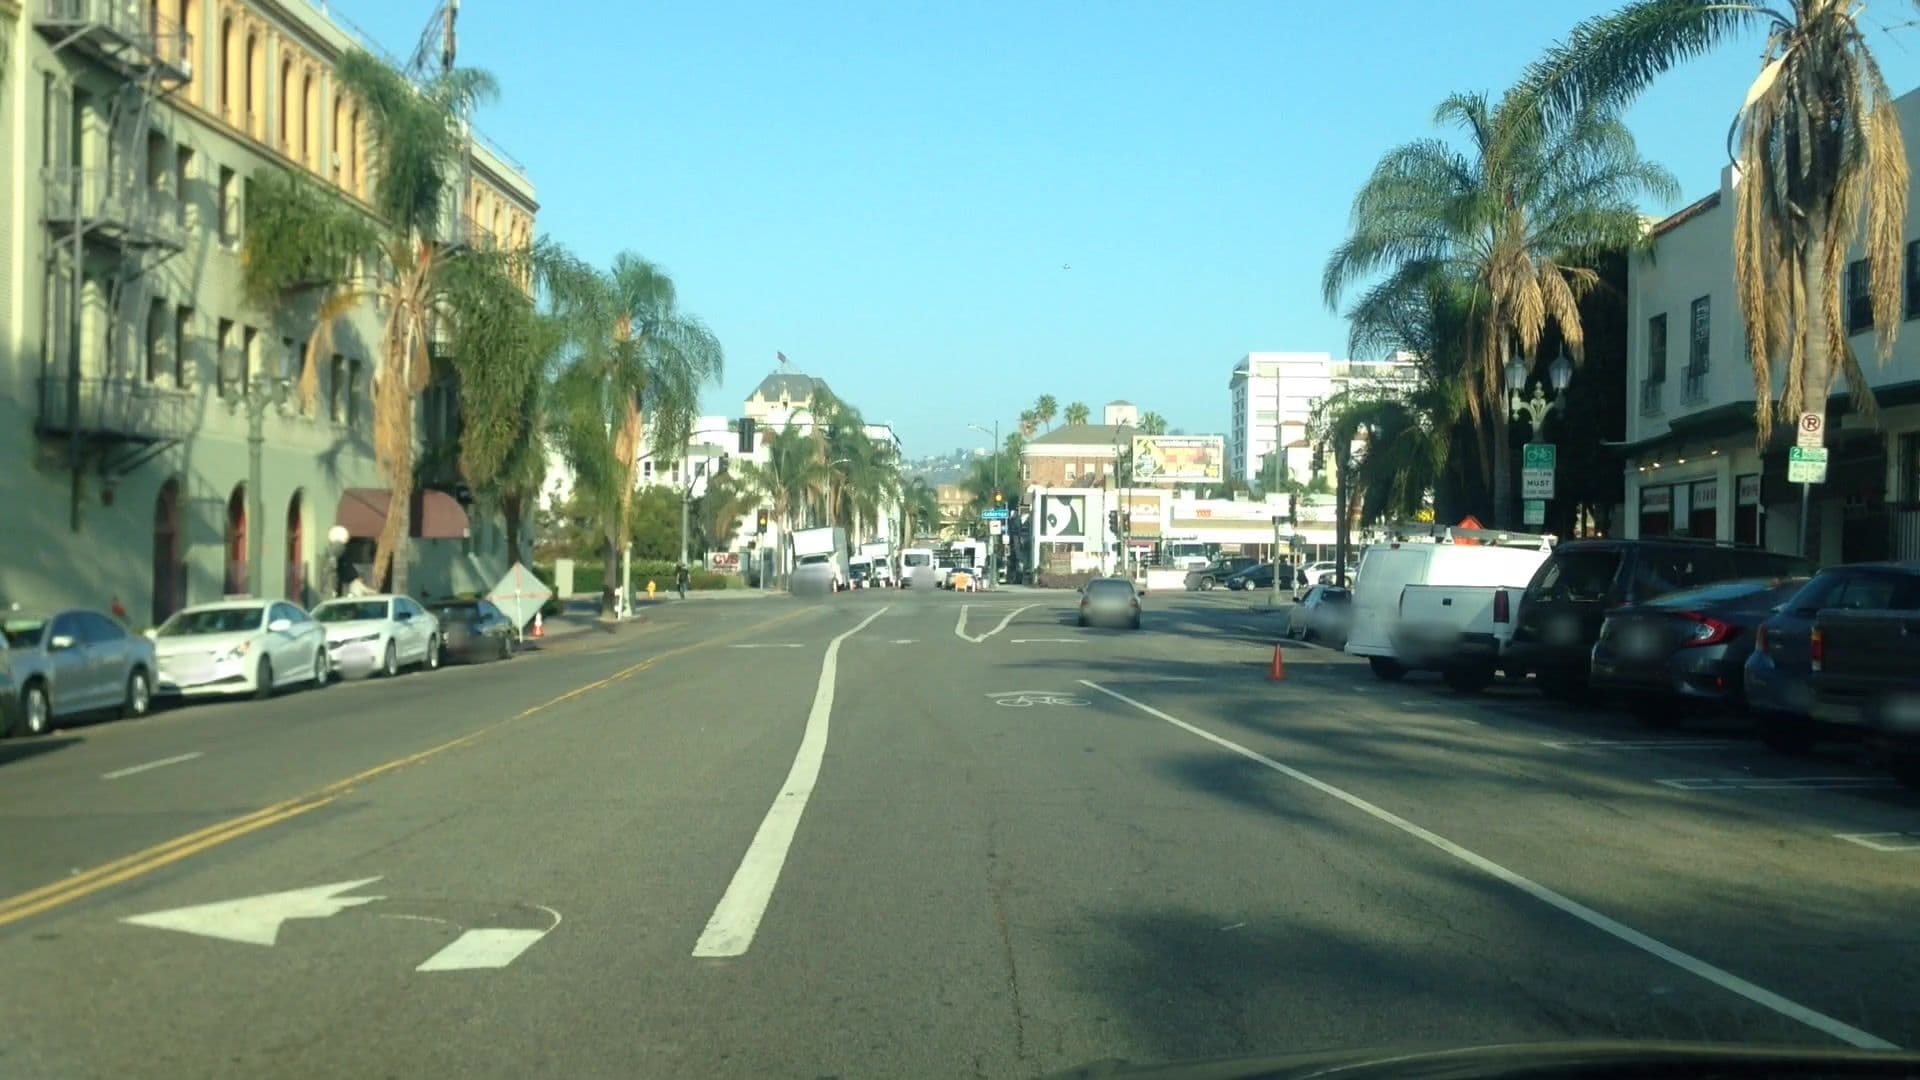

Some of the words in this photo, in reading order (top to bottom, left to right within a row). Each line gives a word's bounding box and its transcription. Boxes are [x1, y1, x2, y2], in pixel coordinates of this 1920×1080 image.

[1793, 448, 1800, 458] 2
[1527, 479, 1550, 487] MUST
[713, 554, 739, 565] CVS
